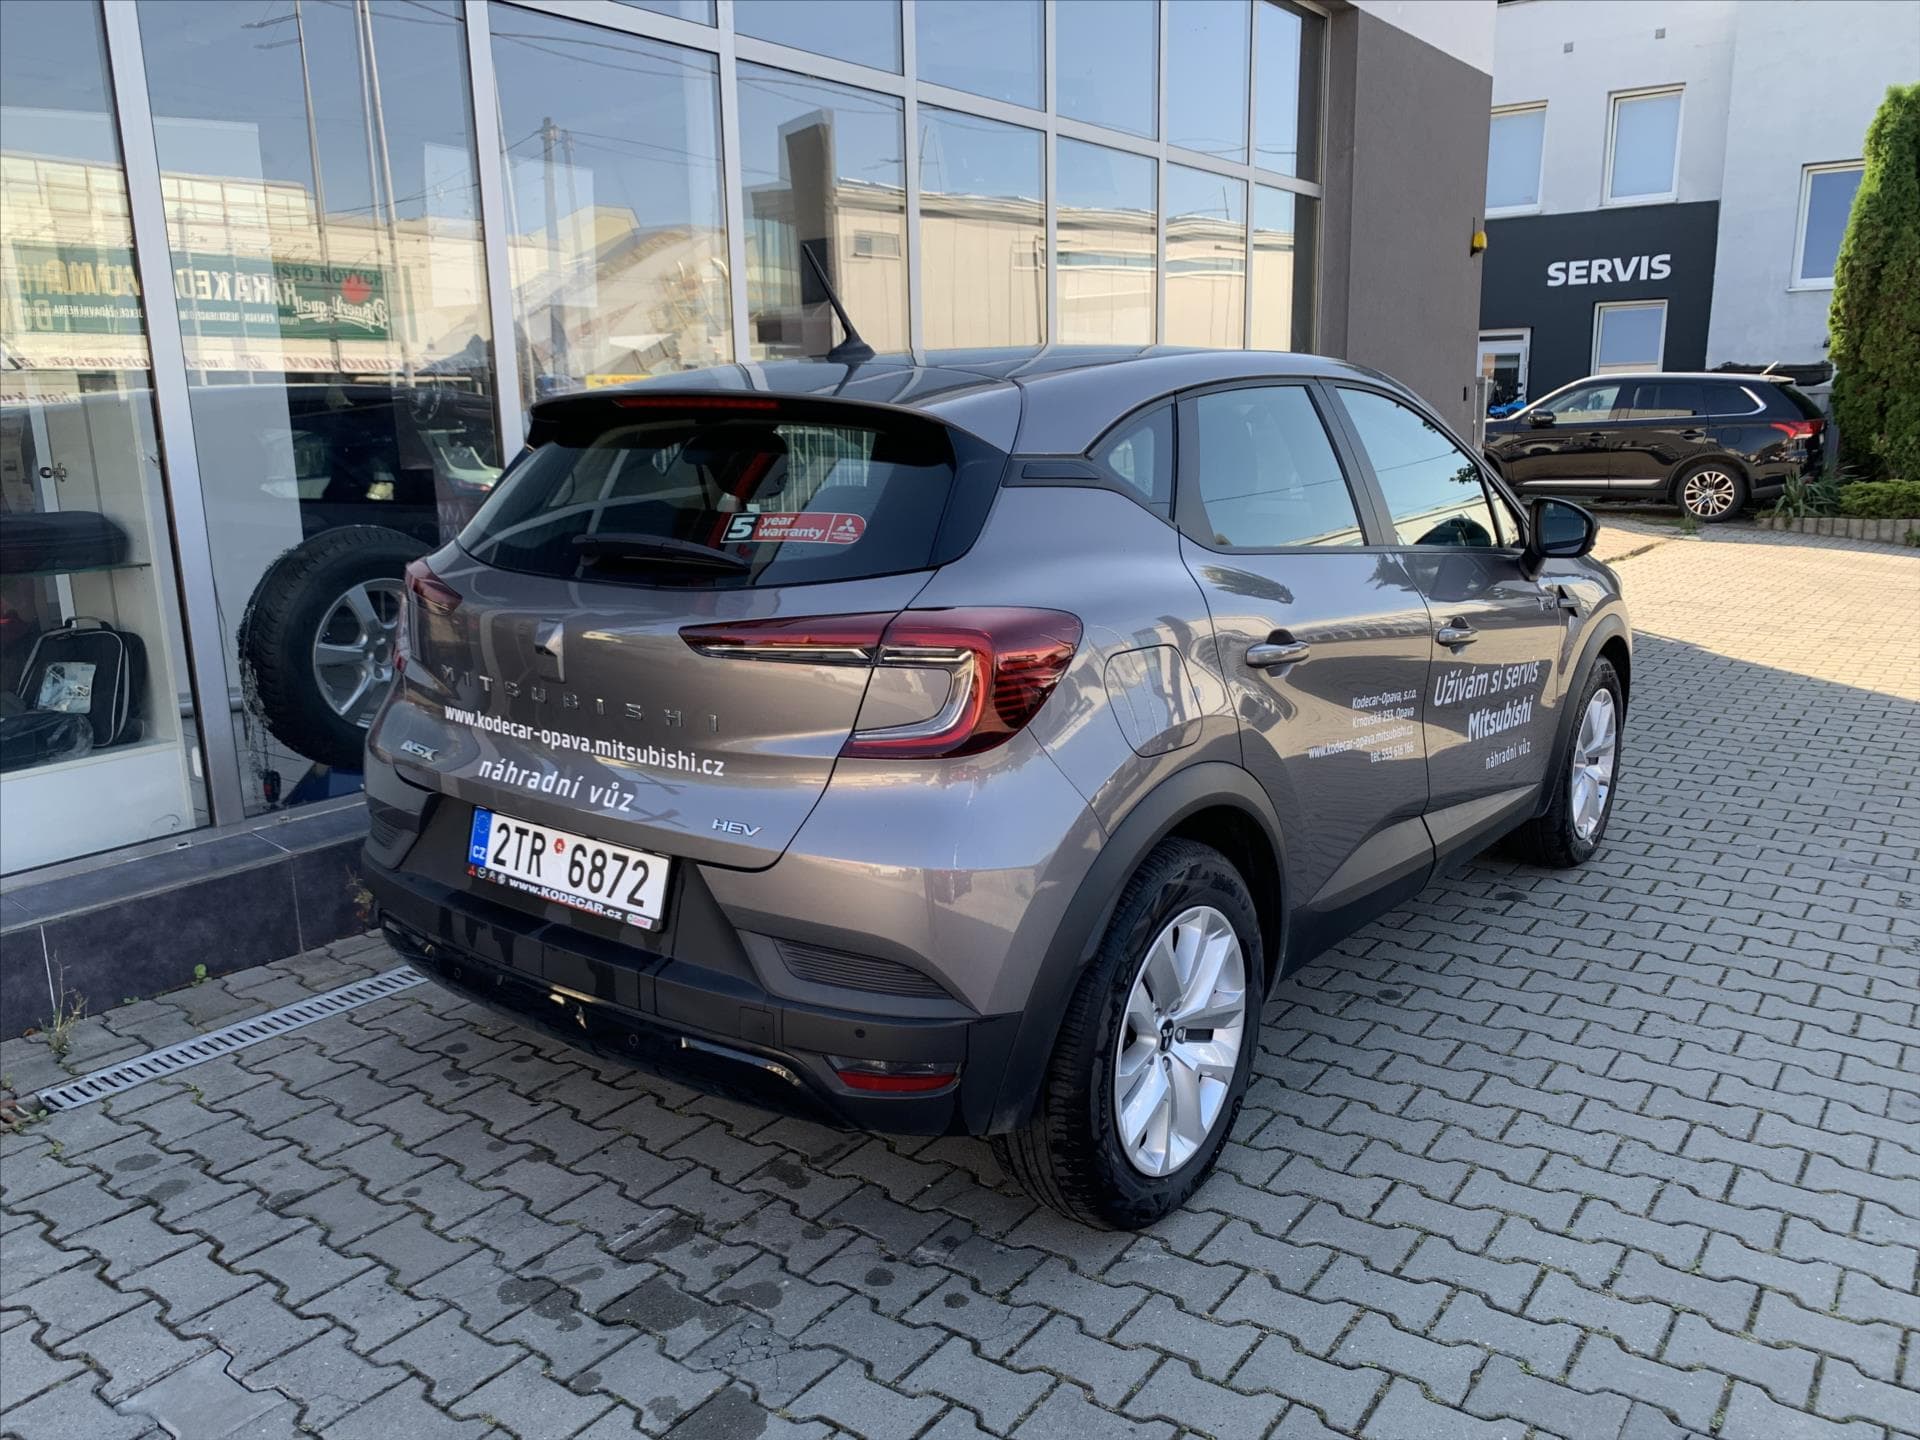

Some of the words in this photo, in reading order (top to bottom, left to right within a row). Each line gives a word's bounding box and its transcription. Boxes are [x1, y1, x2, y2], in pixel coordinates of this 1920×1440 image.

[1547, 254, 1671, 286] SERVIS
[727, 516, 755, 539] 5
[758, 527, 825, 540] warranty
[762, 516, 795, 527] year
[1434, 666, 1489, 707] Užívám
[1490, 663, 1505, 694] si
[1504, 656, 1540, 690] servis
[441, 664, 719, 732] MITSUBISHI
[1396, 707, 1415, 721] Opava
[1468, 694, 1534, 742] Mitsubishi
[400, 739, 439, 762] ASX
[445, 705, 725, 777] www.kodecar-opava.mitsubishi.cz
[1486, 742, 1517, 769] náhradní
[1519, 738, 1531, 756] vůz
[478, 758, 584, 799] náhradní
[589, 782, 635, 812] vůz
[712, 819, 763, 837] HEV
[472, 845, 486, 860] CZ
[493, 823, 546, 877] 2TR
[568, 843, 649, 908] 6872
[509, 878, 622, 920] www.KODECAR.cz
